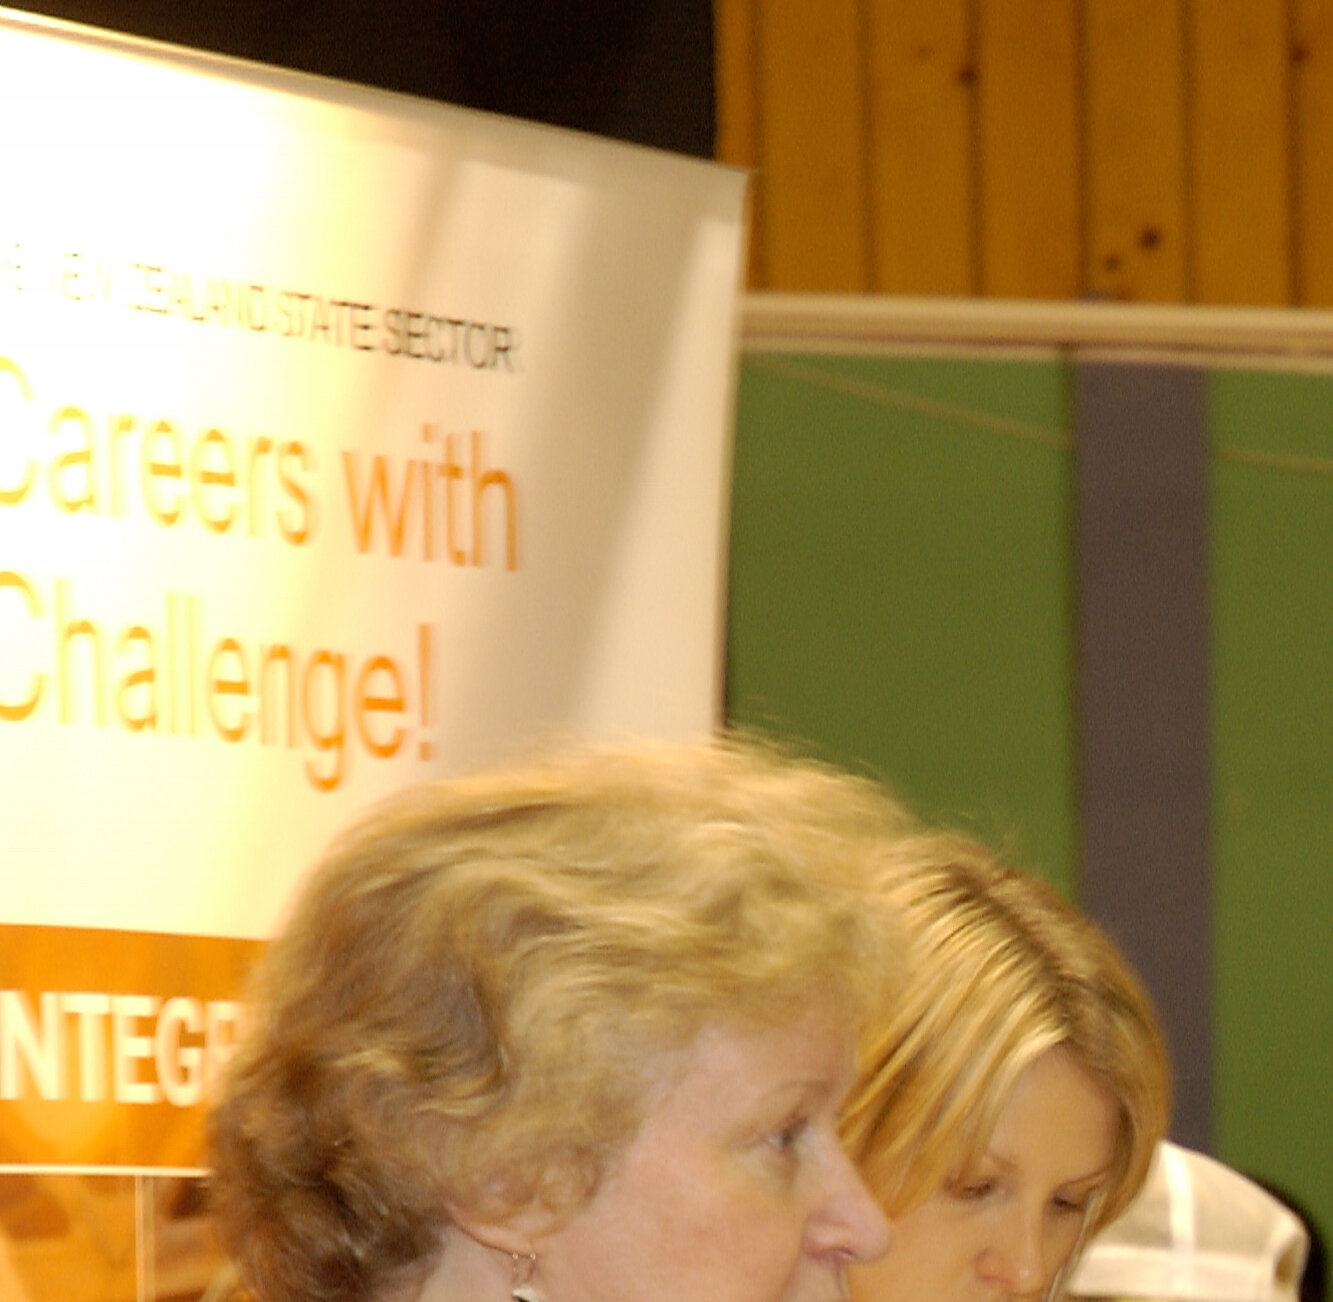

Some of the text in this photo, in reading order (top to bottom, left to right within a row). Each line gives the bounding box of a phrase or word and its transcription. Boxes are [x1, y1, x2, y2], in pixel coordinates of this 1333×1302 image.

[278, 291, 372, 352] STATE
[385, 308, 520, 374] SECTOR
[0, 355, 521, 573] Careers with
[0, 570, 438, 792] Challenge!
